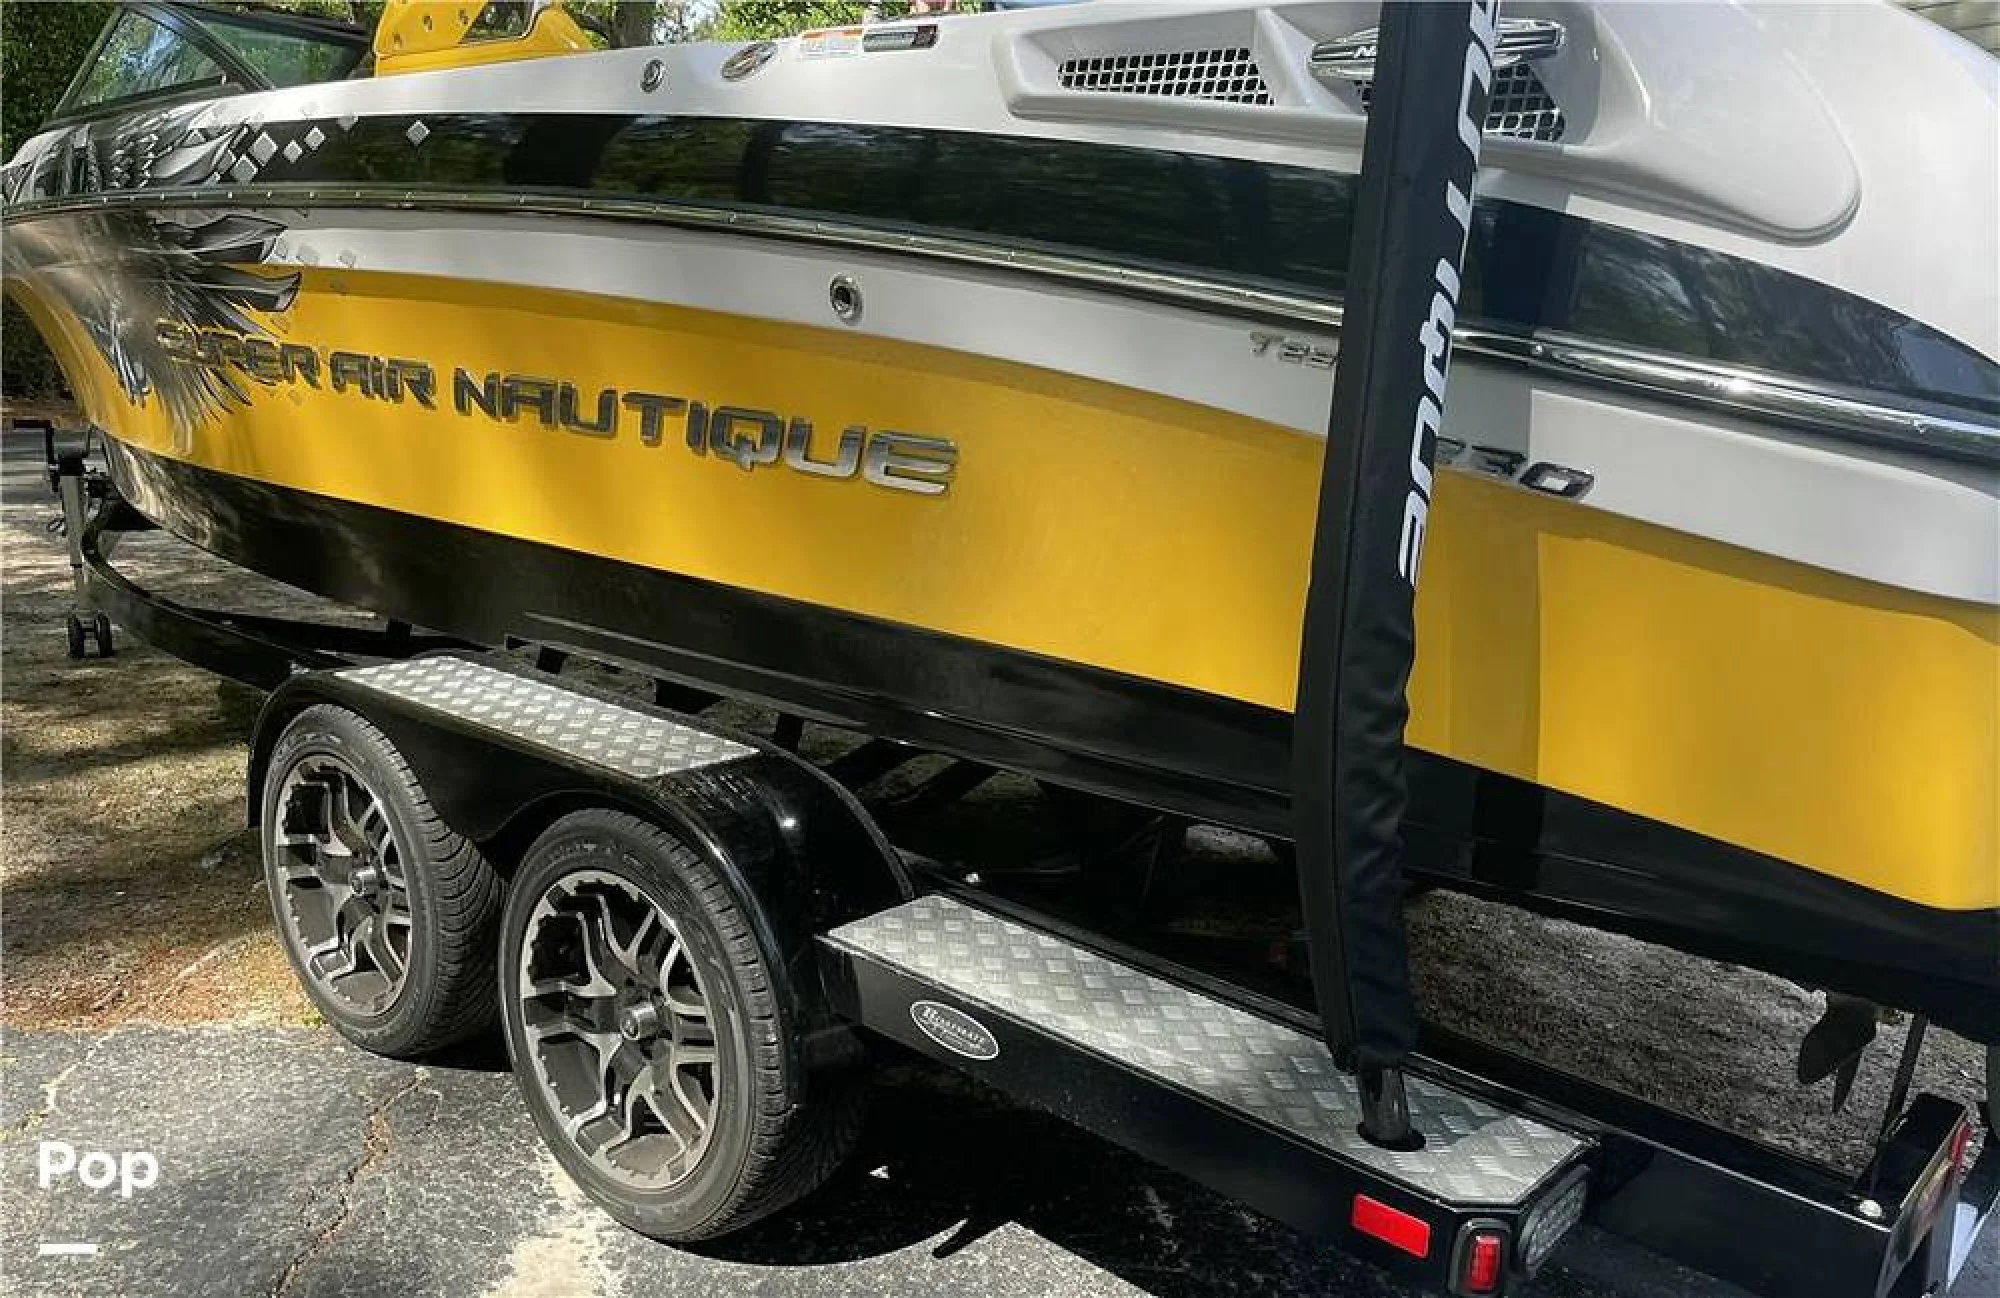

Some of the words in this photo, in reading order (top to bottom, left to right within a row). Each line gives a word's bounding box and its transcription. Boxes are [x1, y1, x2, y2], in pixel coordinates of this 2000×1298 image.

[155, 317, 322, 389] SUPER
[329, 350, 437, 411] AIR
[453, 366, 959, 497] NAUTIQUE
